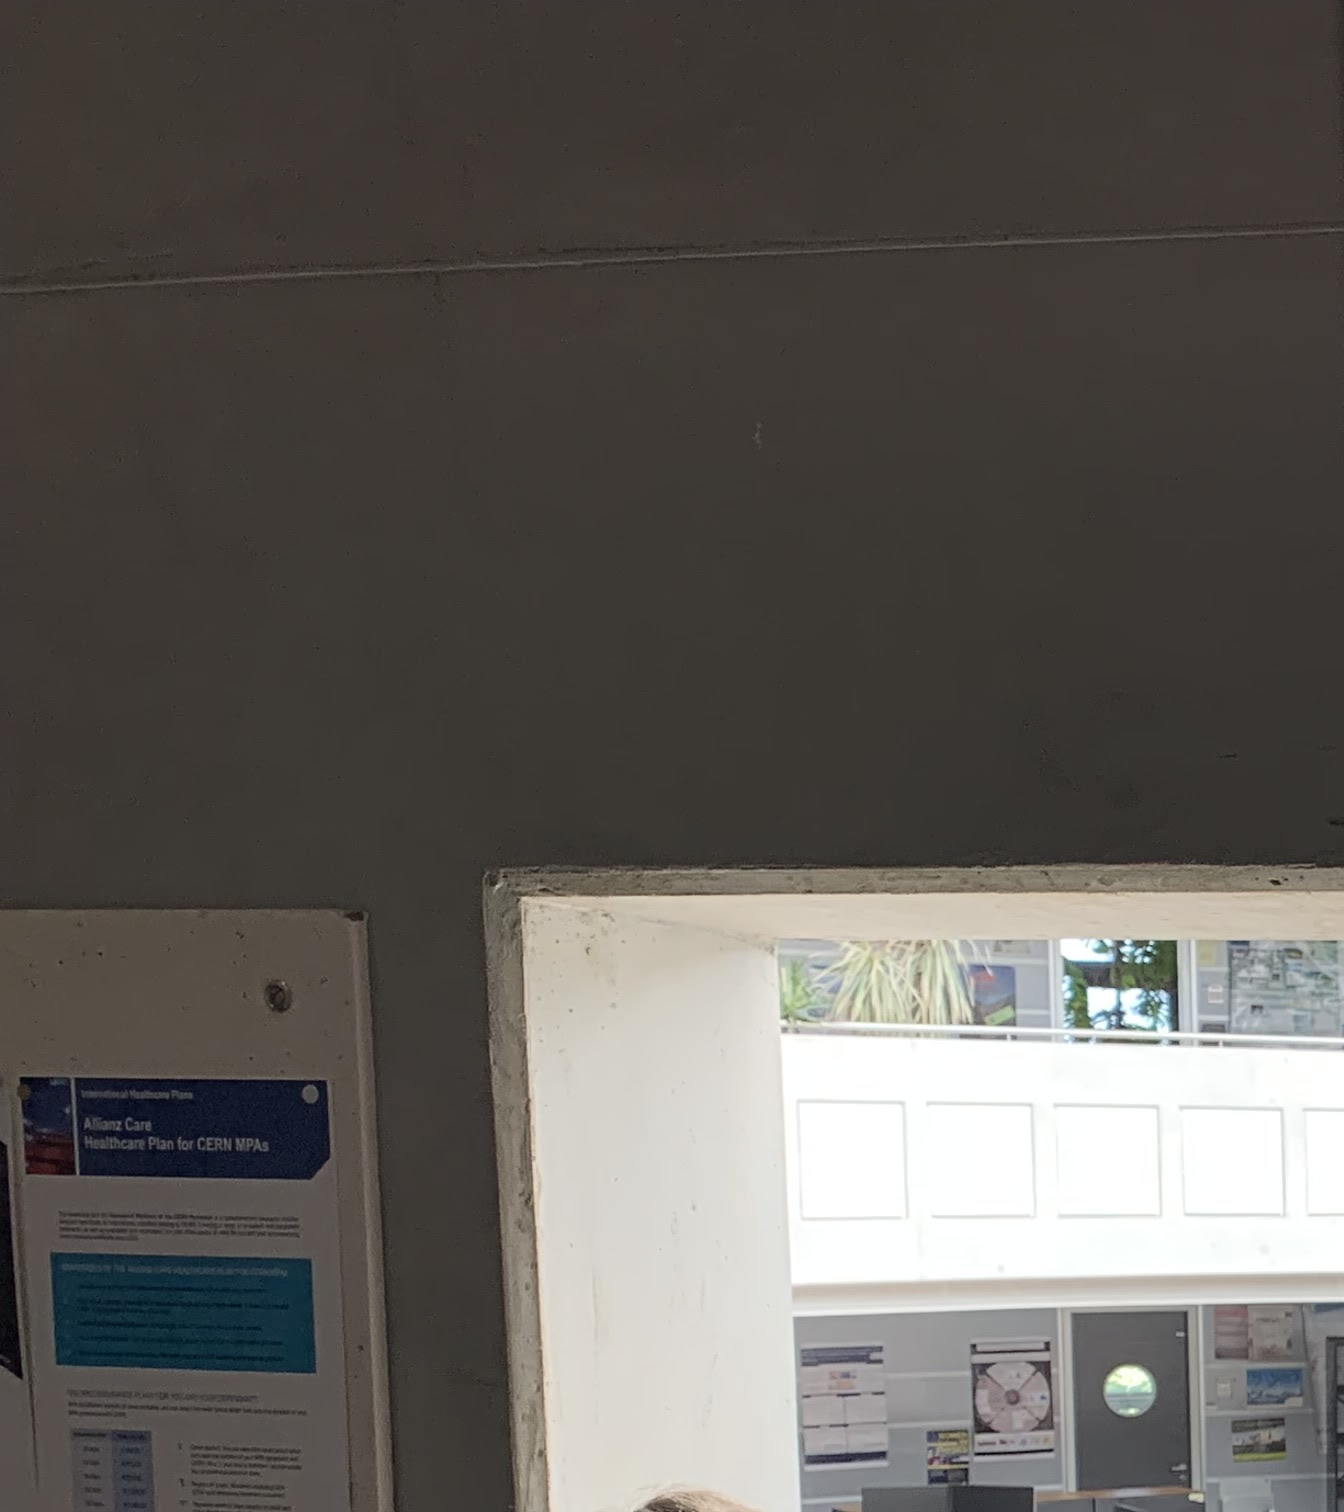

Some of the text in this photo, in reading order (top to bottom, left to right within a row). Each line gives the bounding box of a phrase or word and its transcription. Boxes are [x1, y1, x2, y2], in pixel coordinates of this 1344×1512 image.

[83, 1116, 153, 1132] Allianz Care
[84, 1135, 270, 1152] Healthcare Plan for CERN MPAs
